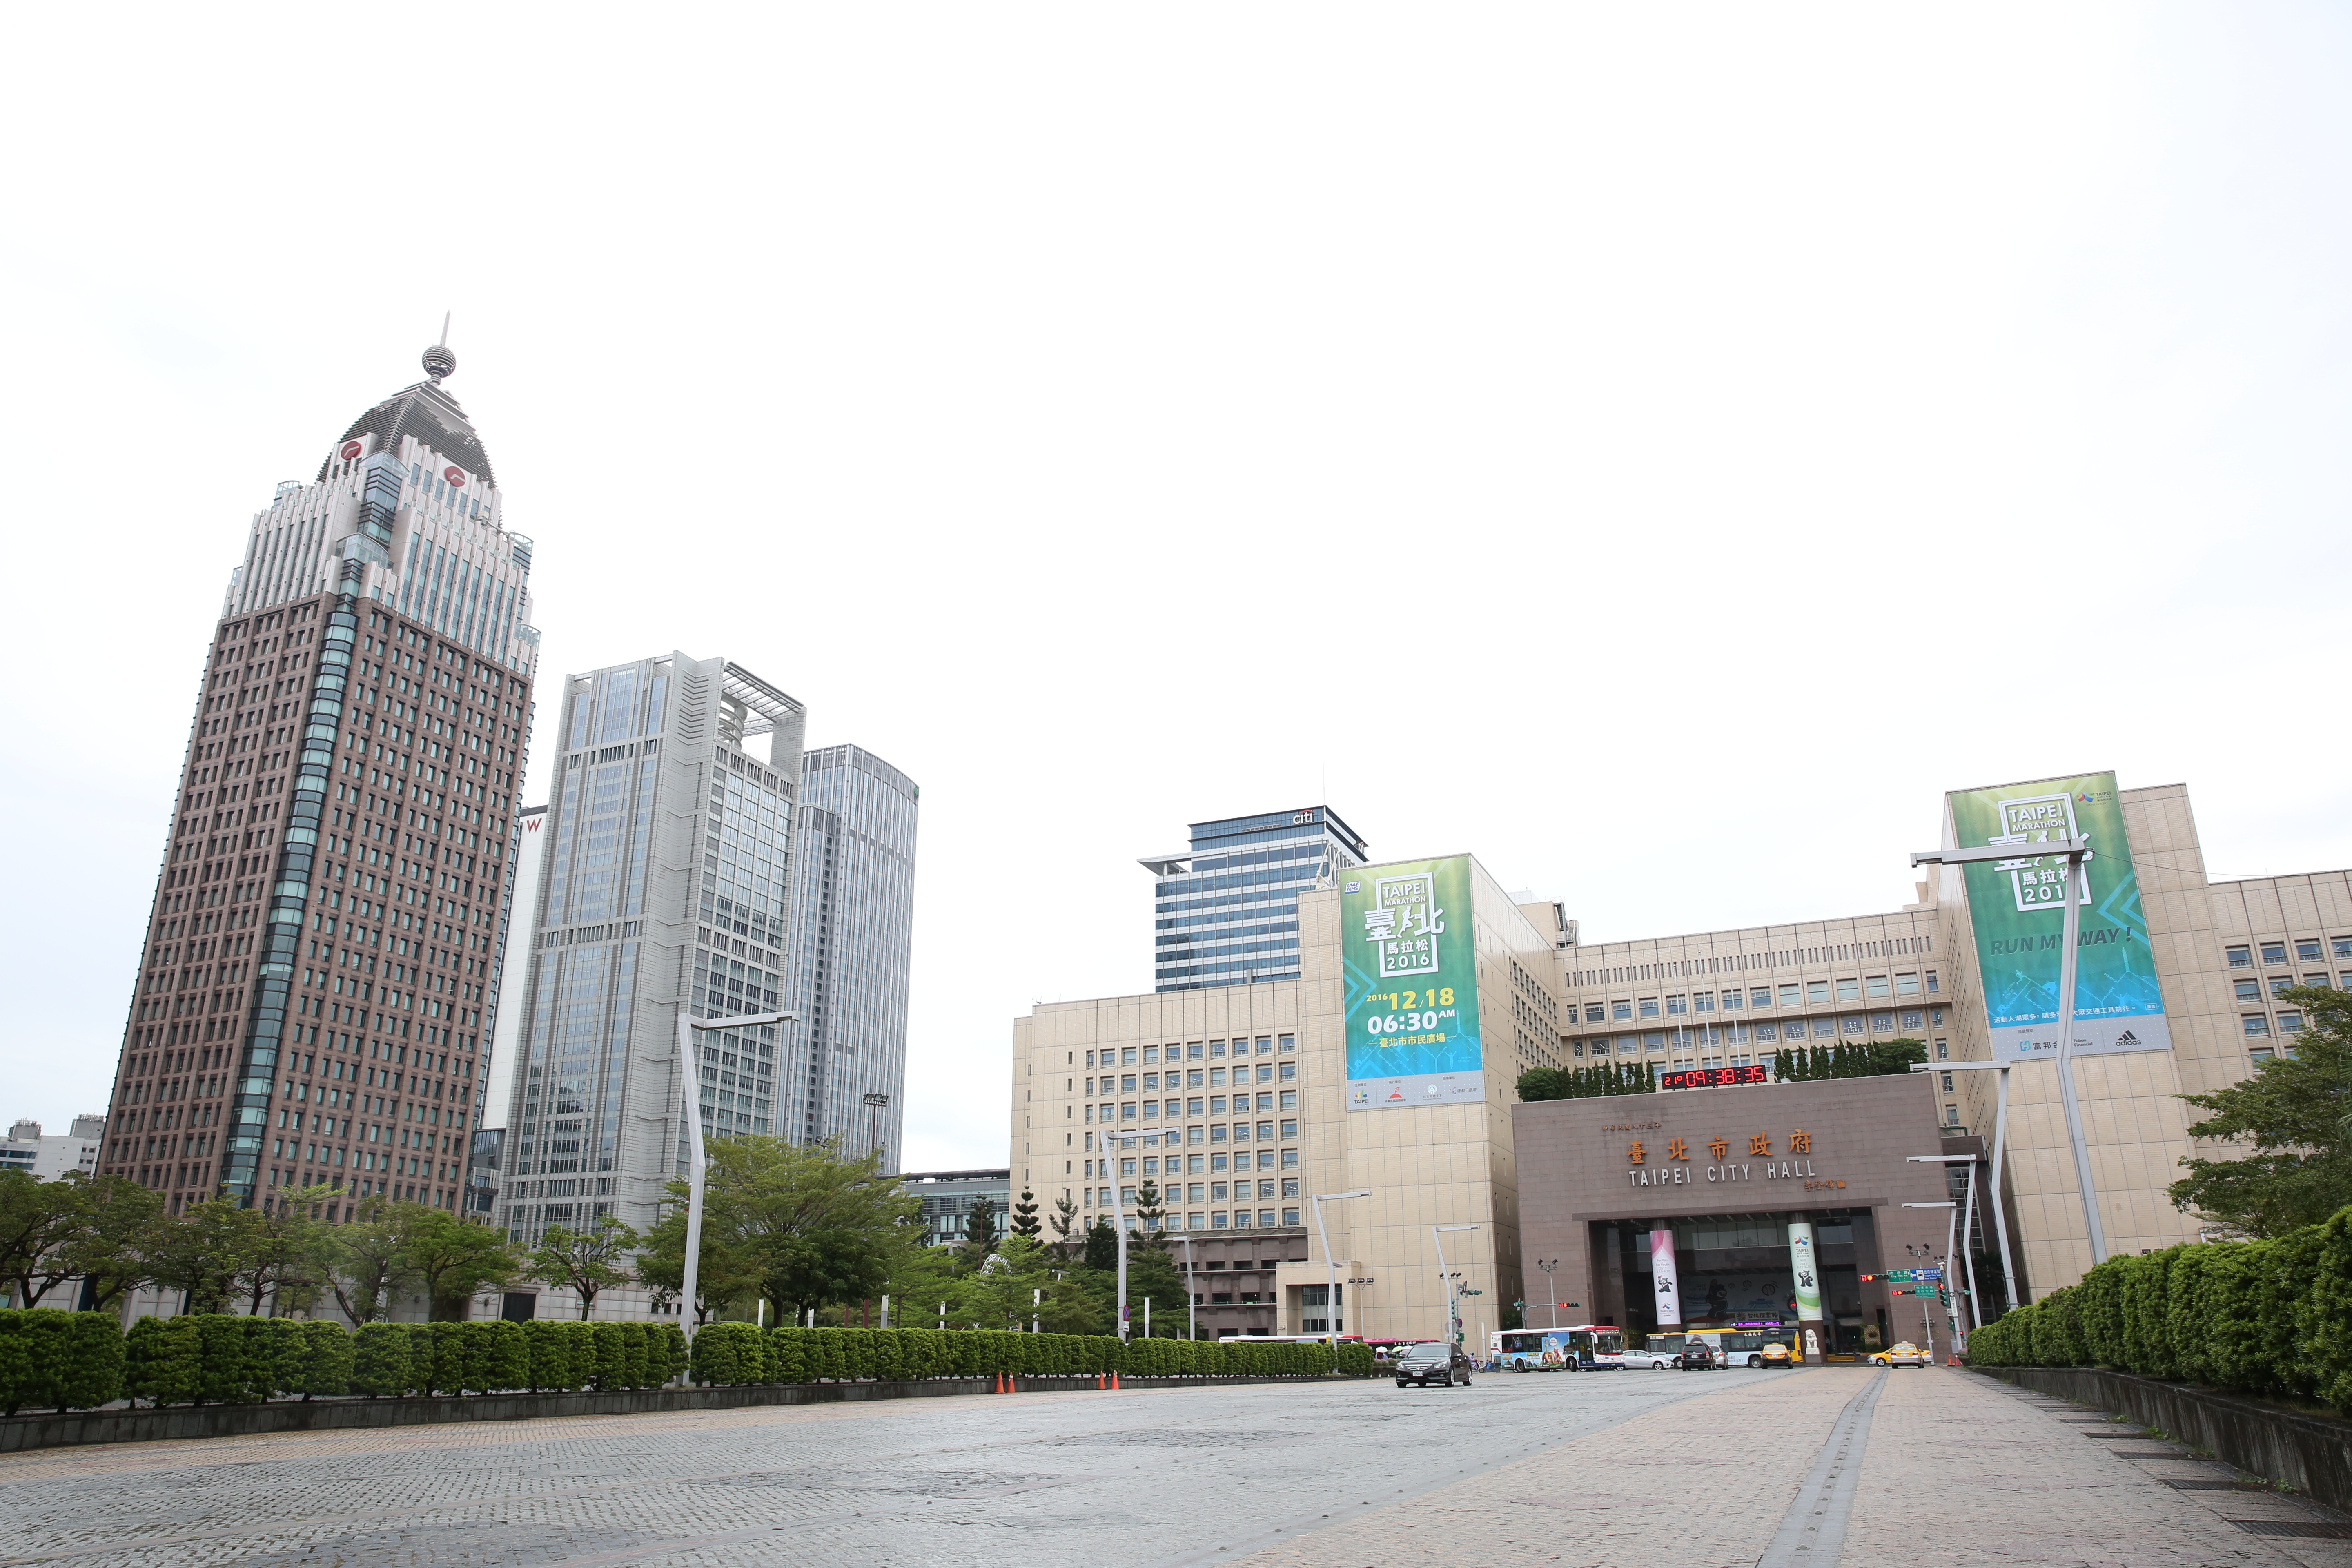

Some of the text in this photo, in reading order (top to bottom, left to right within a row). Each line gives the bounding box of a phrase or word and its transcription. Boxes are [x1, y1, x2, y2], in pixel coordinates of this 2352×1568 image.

[1293, 811, 1313, 824] citi
[2009, 802, 2063, 822] TAIPEI
[526, 817, 543, 833] W
[2013, 819, 2066, 832] MARATHON
[1383, 880, 1425, 898] TAIPEI
[1385, 895, 1426, 906] MARATHON
[1387, 939, 1429, 955] 馬拉松
[1991, 937, 2034, 956] RUN
[2077, 928, 2120, 947] WAY
[1387, 953, 1430, 969] 2016
[1366, 993, 1388, 1002] 2016
[1368, 1009, 1456, 1034] 06:30 AM
[1379, 1033, 1446, 1048] 臺北市市民廣場
[1686, 1066, 1764, 1087] 09:38:35
[1602, 1122, 1661, 1131] 中華民國八十三年
[1627, 1129, 1812, 1164] 臺北市政府
[1629, 1160, 1815, 1186] TAIPEI CITY HALL
